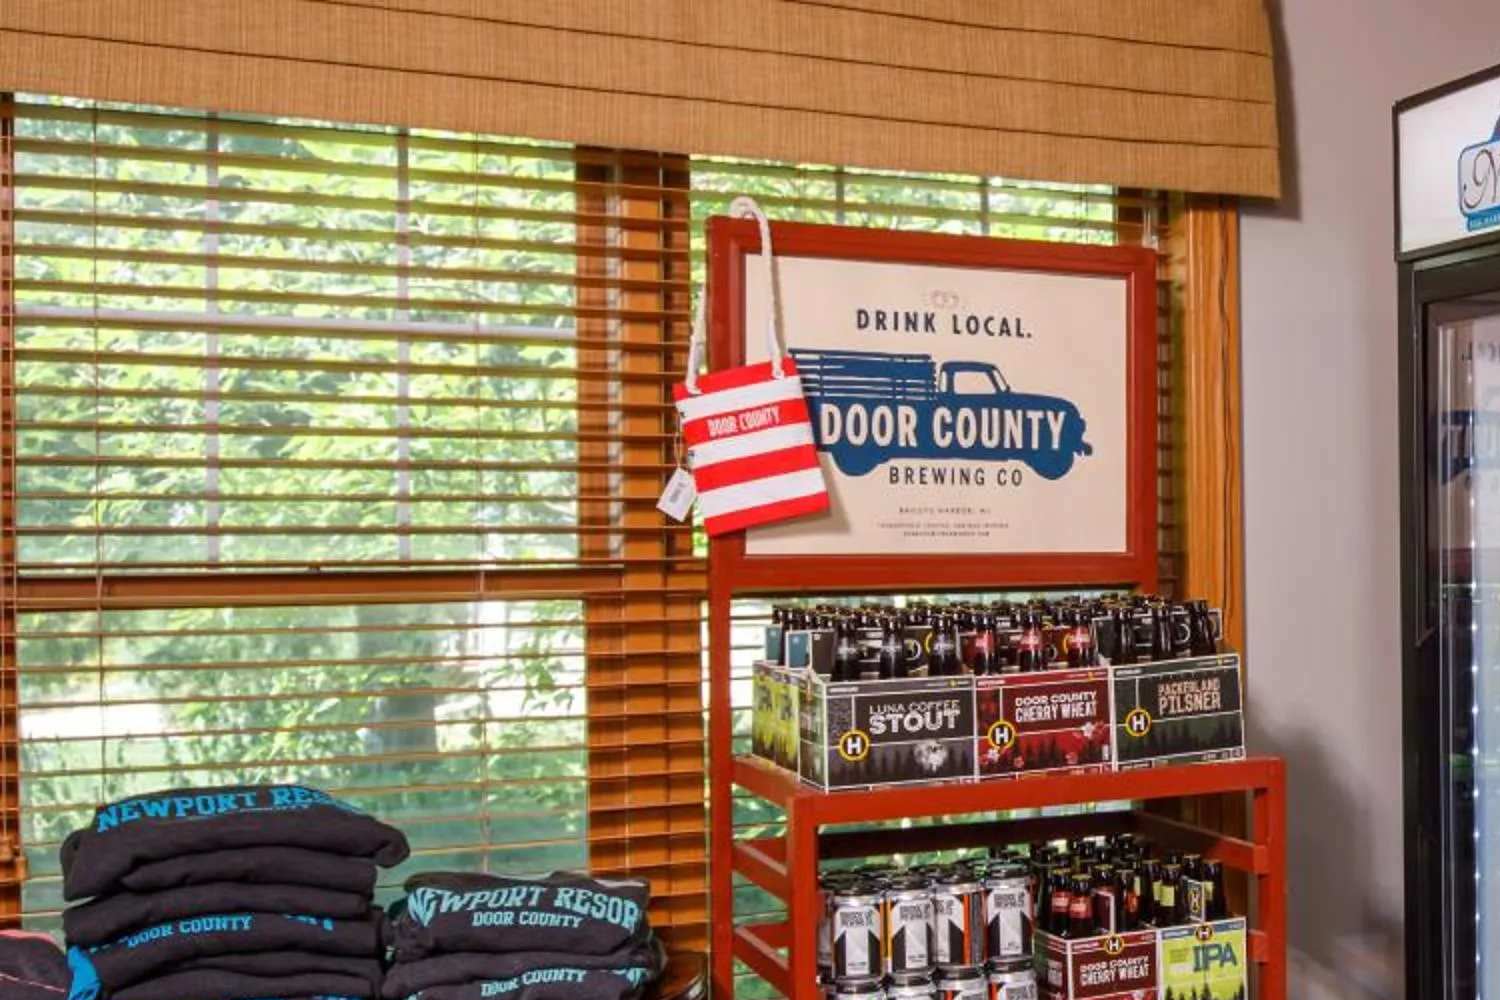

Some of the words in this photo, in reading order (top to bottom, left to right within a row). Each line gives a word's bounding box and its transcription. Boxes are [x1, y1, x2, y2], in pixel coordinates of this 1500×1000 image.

[856, 309, 936, 334] DRINK
[952, 313, 1033, 338] LOCAL.
[707, 414, 738, 437] DOOR
[739, 404, 780, 431] COUNTY
[820, 403, 918, 449] DOOR
[933, 405, 1067, 450] COUNTY
[889, 466, 985, 487] BREWING
[997, 468, 1023, 487] CO
[869, 703, 906, 715] LUNA
[1015, 695, 1049, 708] DOOR
[1050, 691, 1097, 704] COUNTY
[1015, 703, 1059, 723] CHERRY
[1061, 700, 1097, 720] WHEAT
[1158, 691, 1221, 717] PILSNER
[869, 708, 960, 735] STOUT
[97, 790, 257, 832] NEWPORT
[407, 882, 547, 928] NEWPORT
[554, 886, 641, 934] RESOR
[472, 911, 514, 927] DOOR
[519, 911, 584, 928] COUNTY
[127, 925, 173, 948] DOOR
[179, 914, 253, 934] COUNTY
[1192, 942, 1237, 973] IPA
[480, 979, 518, 997] DOOR
[521, 967, 588, 985] COUNTY
[1081, 970, 1116, 987] CHERRY
[1119, 963, 1150, 982] WHEAT
